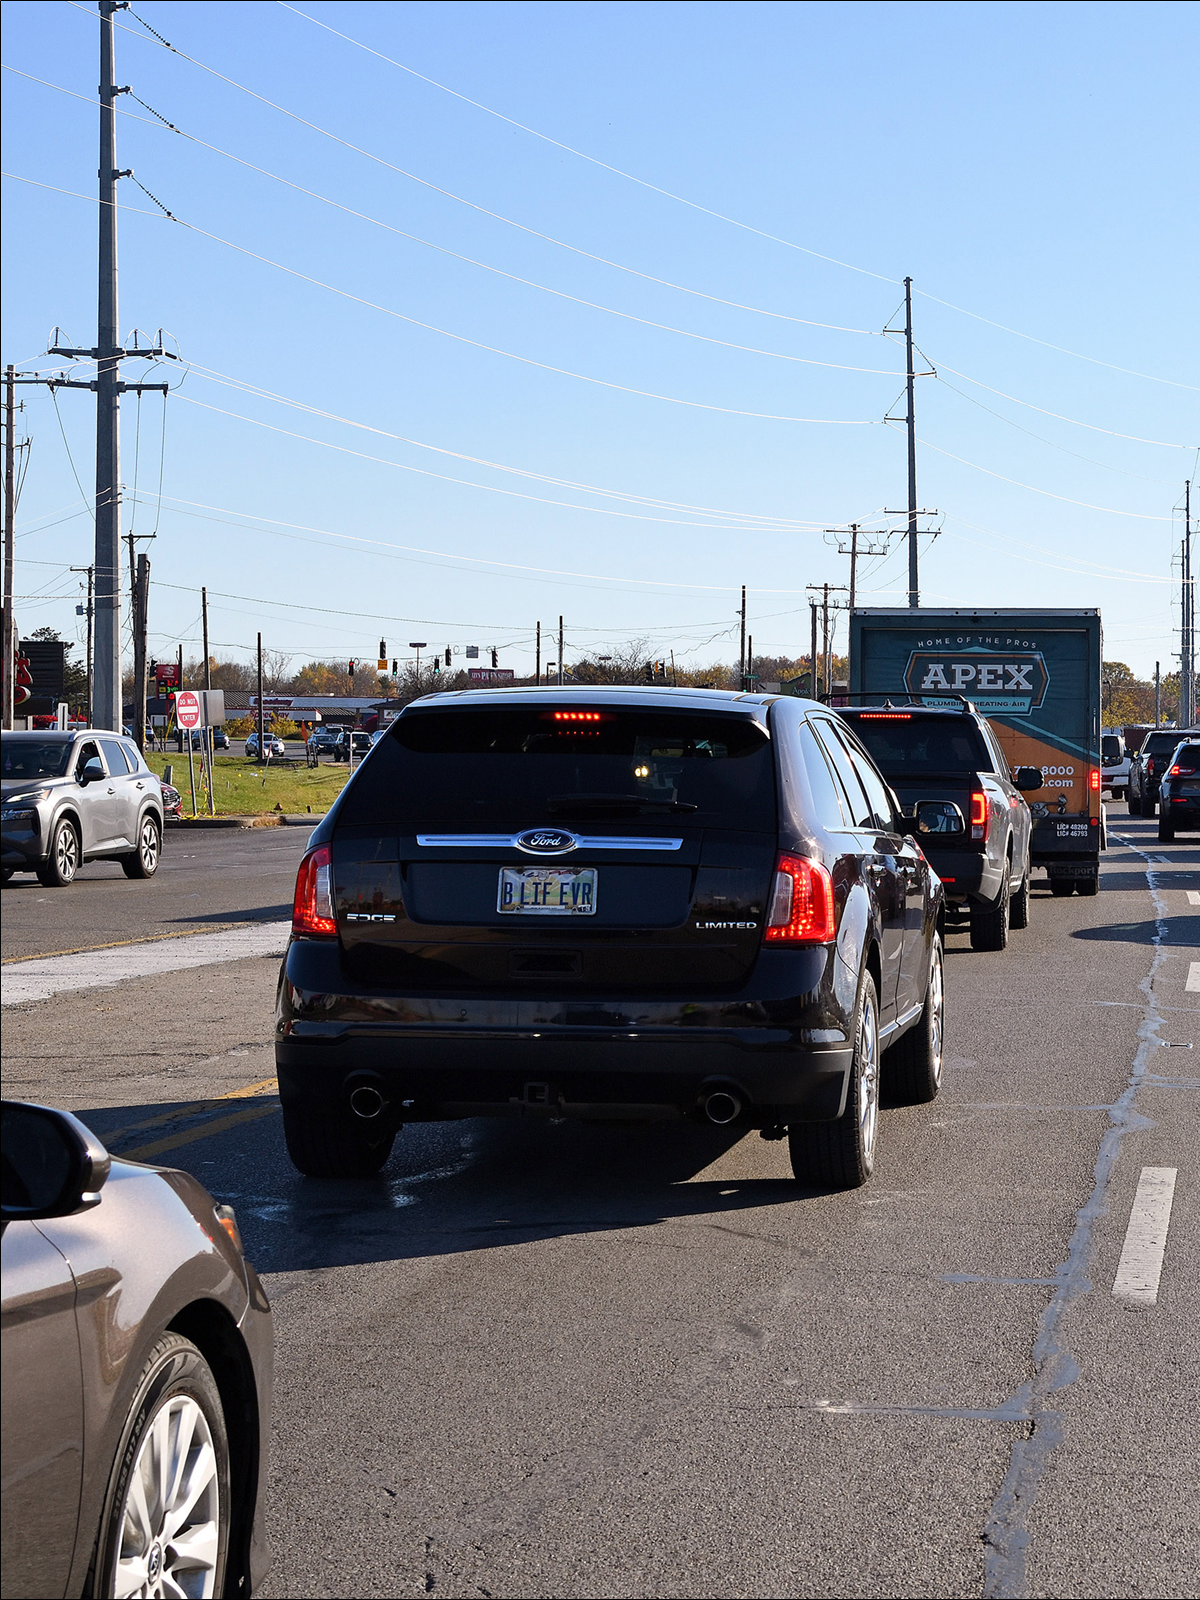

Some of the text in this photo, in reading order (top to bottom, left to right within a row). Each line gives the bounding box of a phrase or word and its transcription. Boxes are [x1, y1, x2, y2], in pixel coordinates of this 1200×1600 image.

[918, 636, 1037, 649] HOME OF THE PROS
[921, 663, 1034, 690] APEX
[179, 697, 196, 706] DO NOT
[926, 700, 966, 708] PLUMBIN
[182, 714, 196, 722] ENTER
[530, 832, 561, 847] Ford
[503, 881, 514, 906] B
[559, 882, 592, 907] EVR
[346, 913, 397, 923] EDGE
[695, 921, 758, 930] LIMITED
